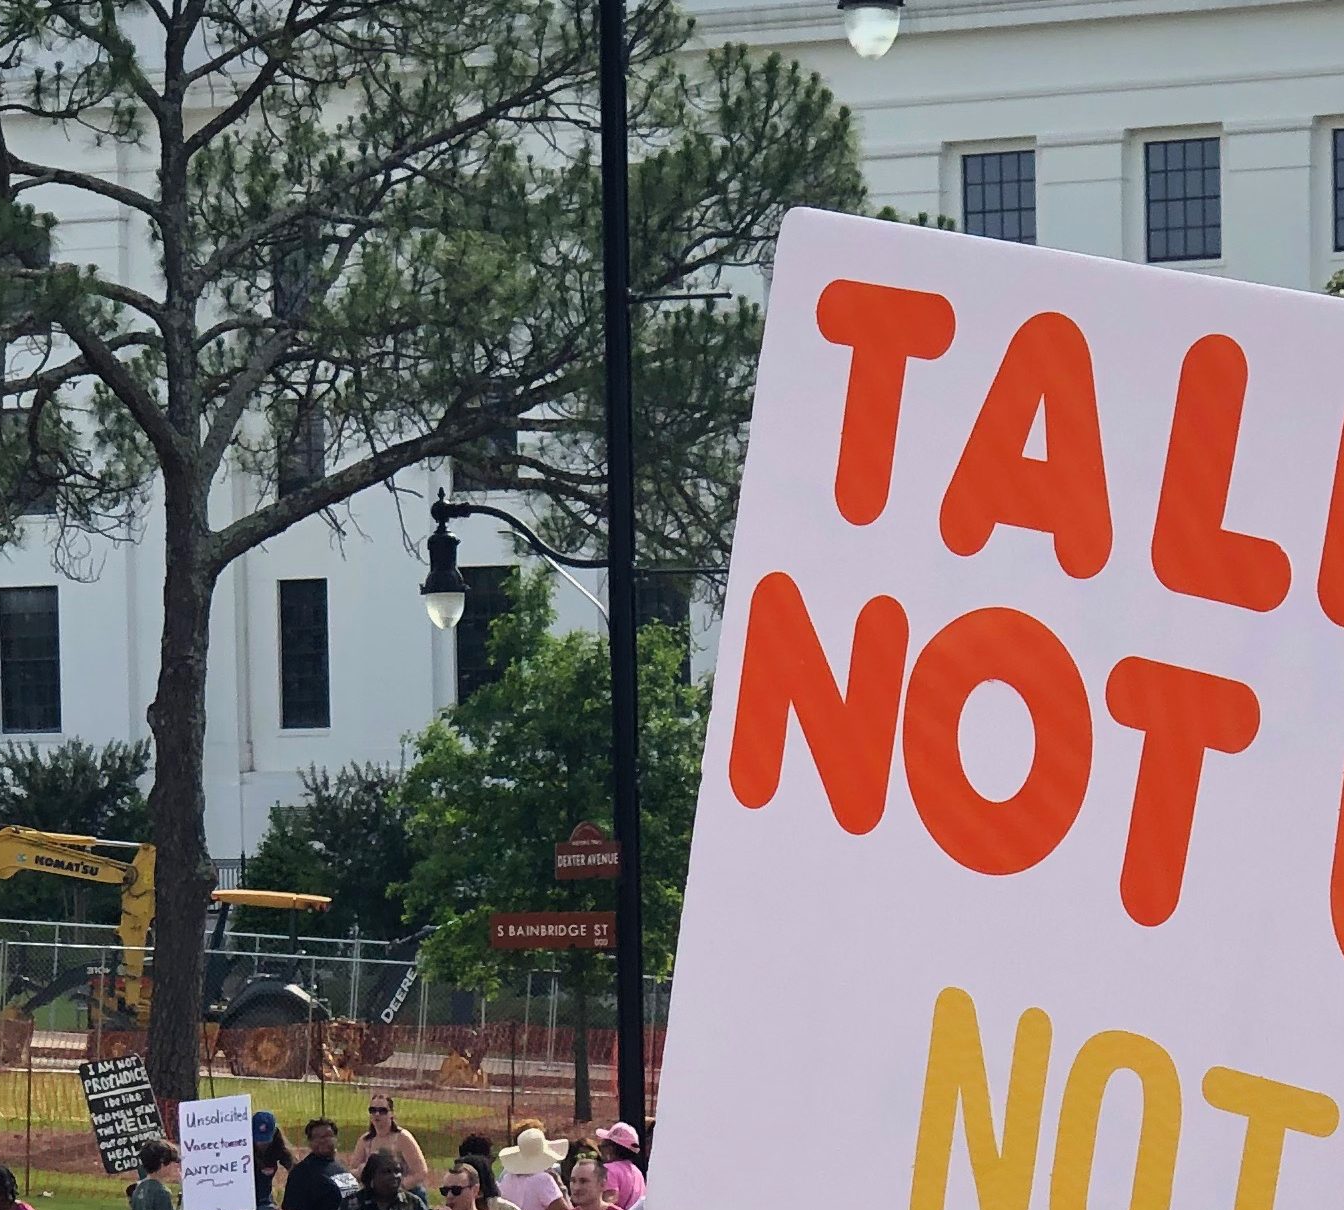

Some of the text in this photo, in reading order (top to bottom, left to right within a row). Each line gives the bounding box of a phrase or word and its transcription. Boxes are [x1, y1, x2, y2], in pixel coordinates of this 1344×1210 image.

[727, 571, 1261, 927] NOT
[34, 854, 99, 877] KOMATSU
[557, 852, 619, 868] DEXTER AVENUE
[497, 924, 609, 937] S BAINBRIDGE ST
[380, 966, 419, 1025] DEERE
[88, 1056, 138, 1076] I AM NOT
[97, 1114, 157, 1137] THE HELL
[185, 1106, 249, 1129] Unsolicited
[107, 1144, 140, 1162] HEAL
